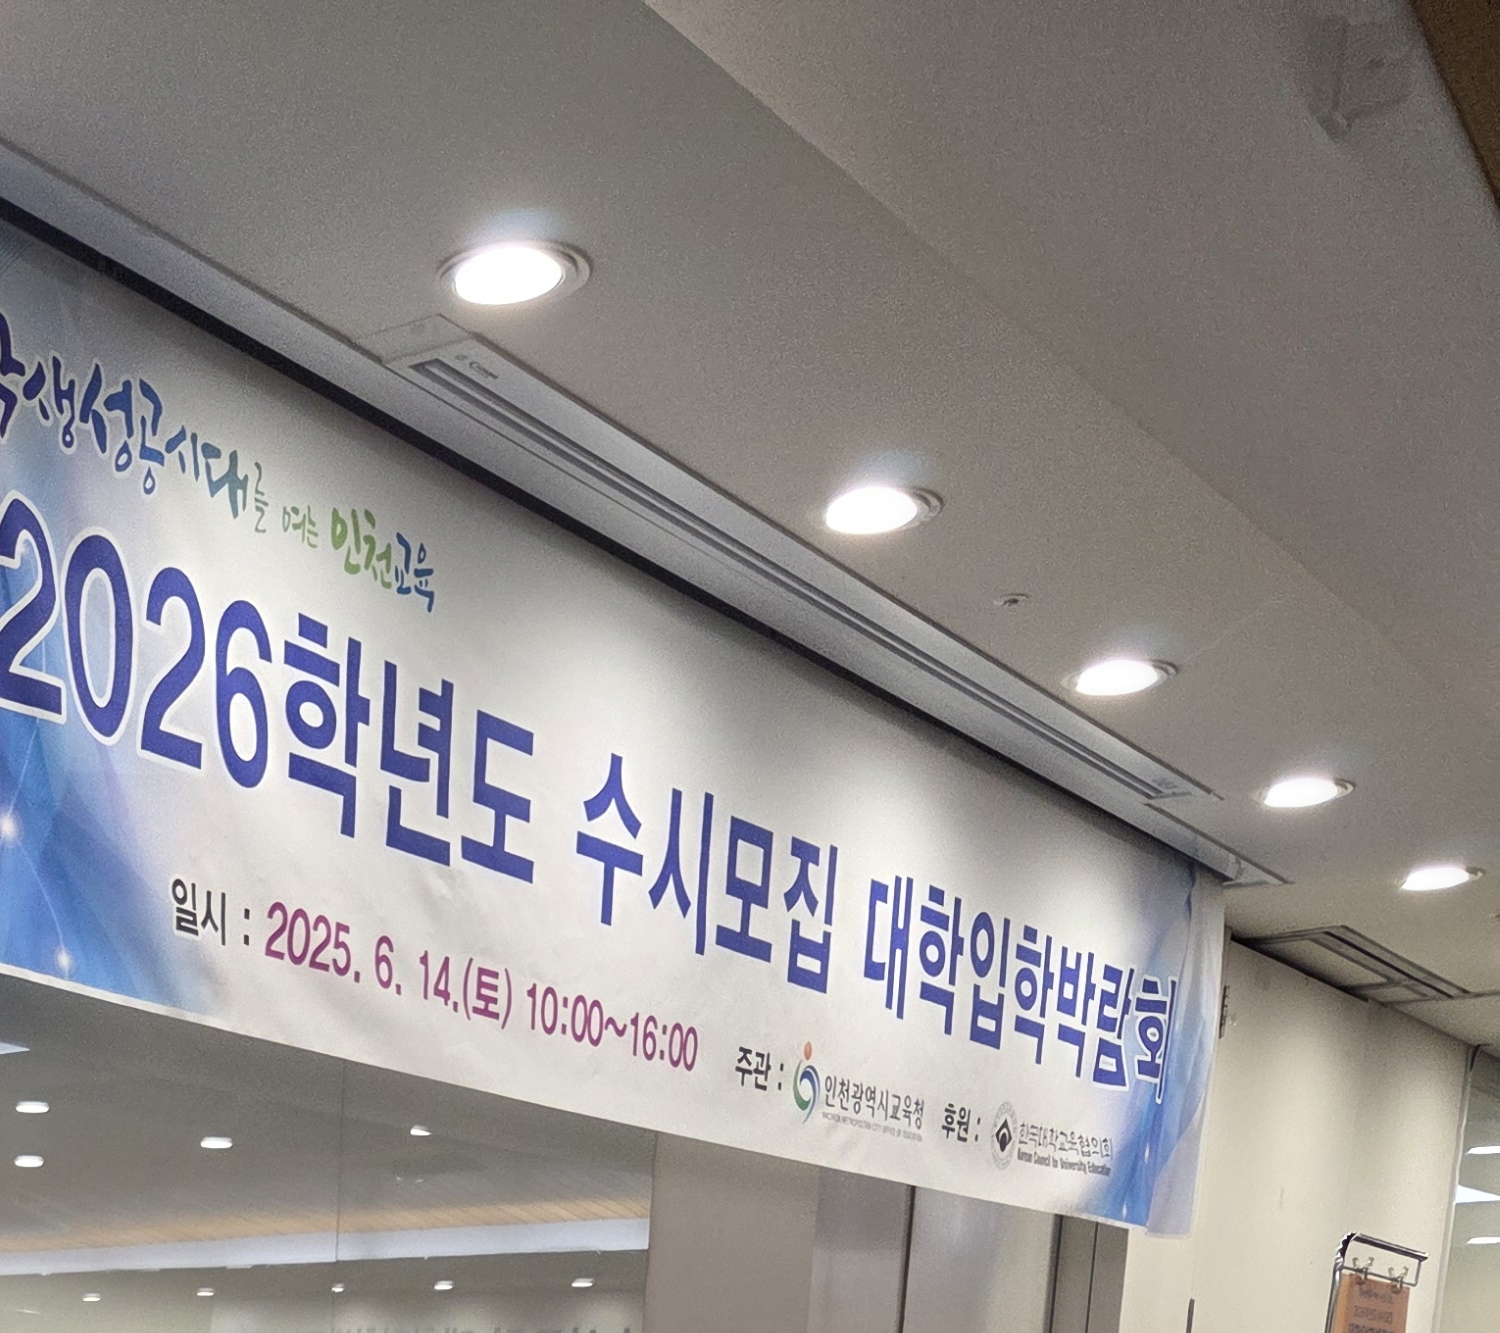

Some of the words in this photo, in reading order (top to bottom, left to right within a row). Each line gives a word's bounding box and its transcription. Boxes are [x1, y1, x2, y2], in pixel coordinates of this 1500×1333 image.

[282, 504, 319, 549] 여는
[331, 507, 435, 614] 인천교육
[171, 878, 227, 946] 일시
[264, 901, 361, 984] 2025.
[374, 934, 402, 996] 6.
[526, 982, 699, 1072] 10:00~16:00
[575, 752, 839, 995] 수시모집
[863, 875, 1177, 1102] 대학입학박람회
[735, 1046, 772, 1092] 주관
[824, 1074, 925, 1131] 인천광역시교육청
[941, 1102, 972, 1143] 후원
